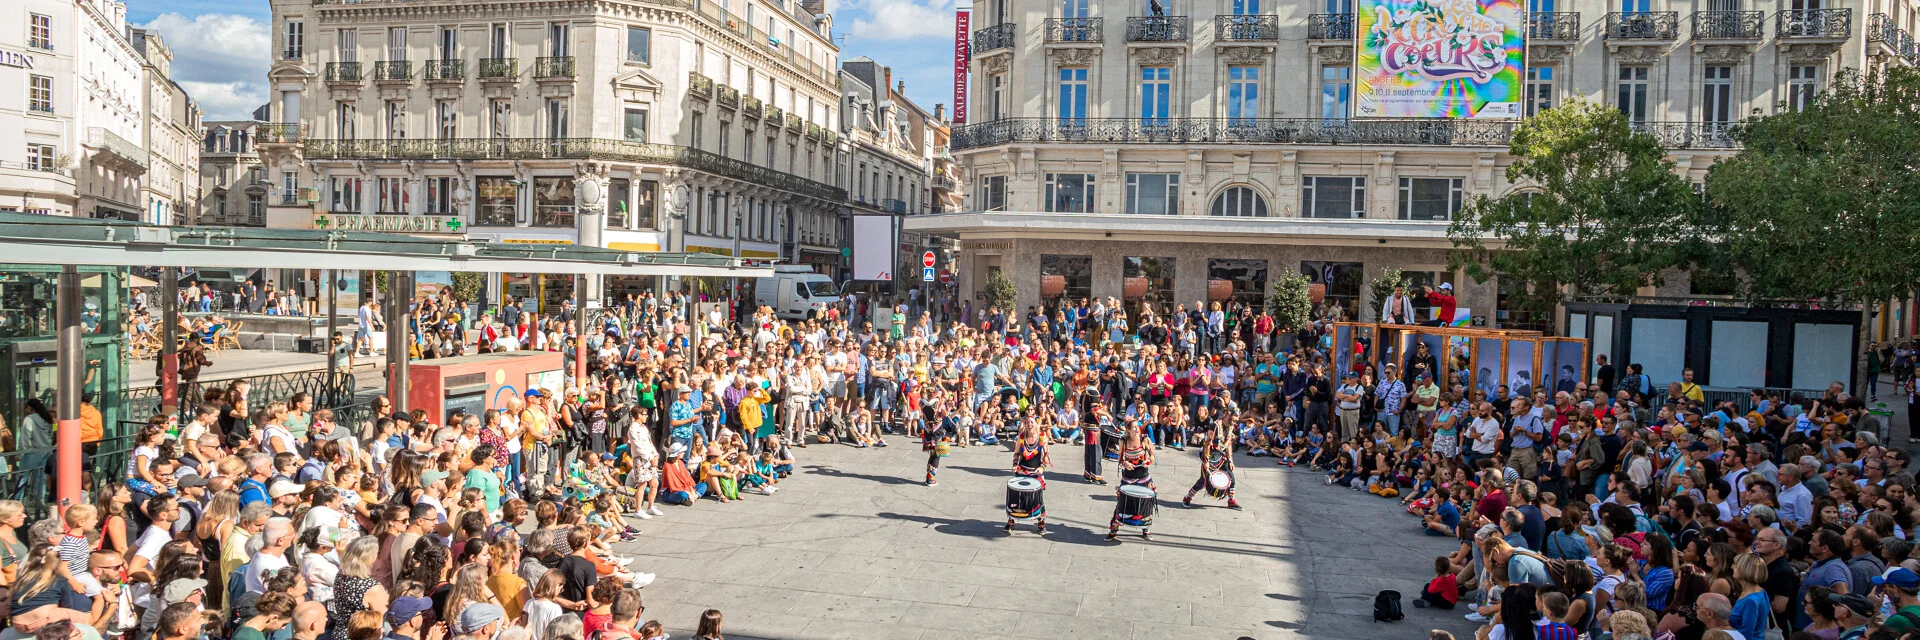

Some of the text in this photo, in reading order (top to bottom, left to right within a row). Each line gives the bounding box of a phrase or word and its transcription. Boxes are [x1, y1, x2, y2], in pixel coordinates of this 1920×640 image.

[956, 16, 967, 119] GALERIES LAFAYETTE
[1368, 75, 1402, 84] ANGERS
[1392, 88, 1436, 97] septembre
[334, 215, 442, 232] PHARMACIE
